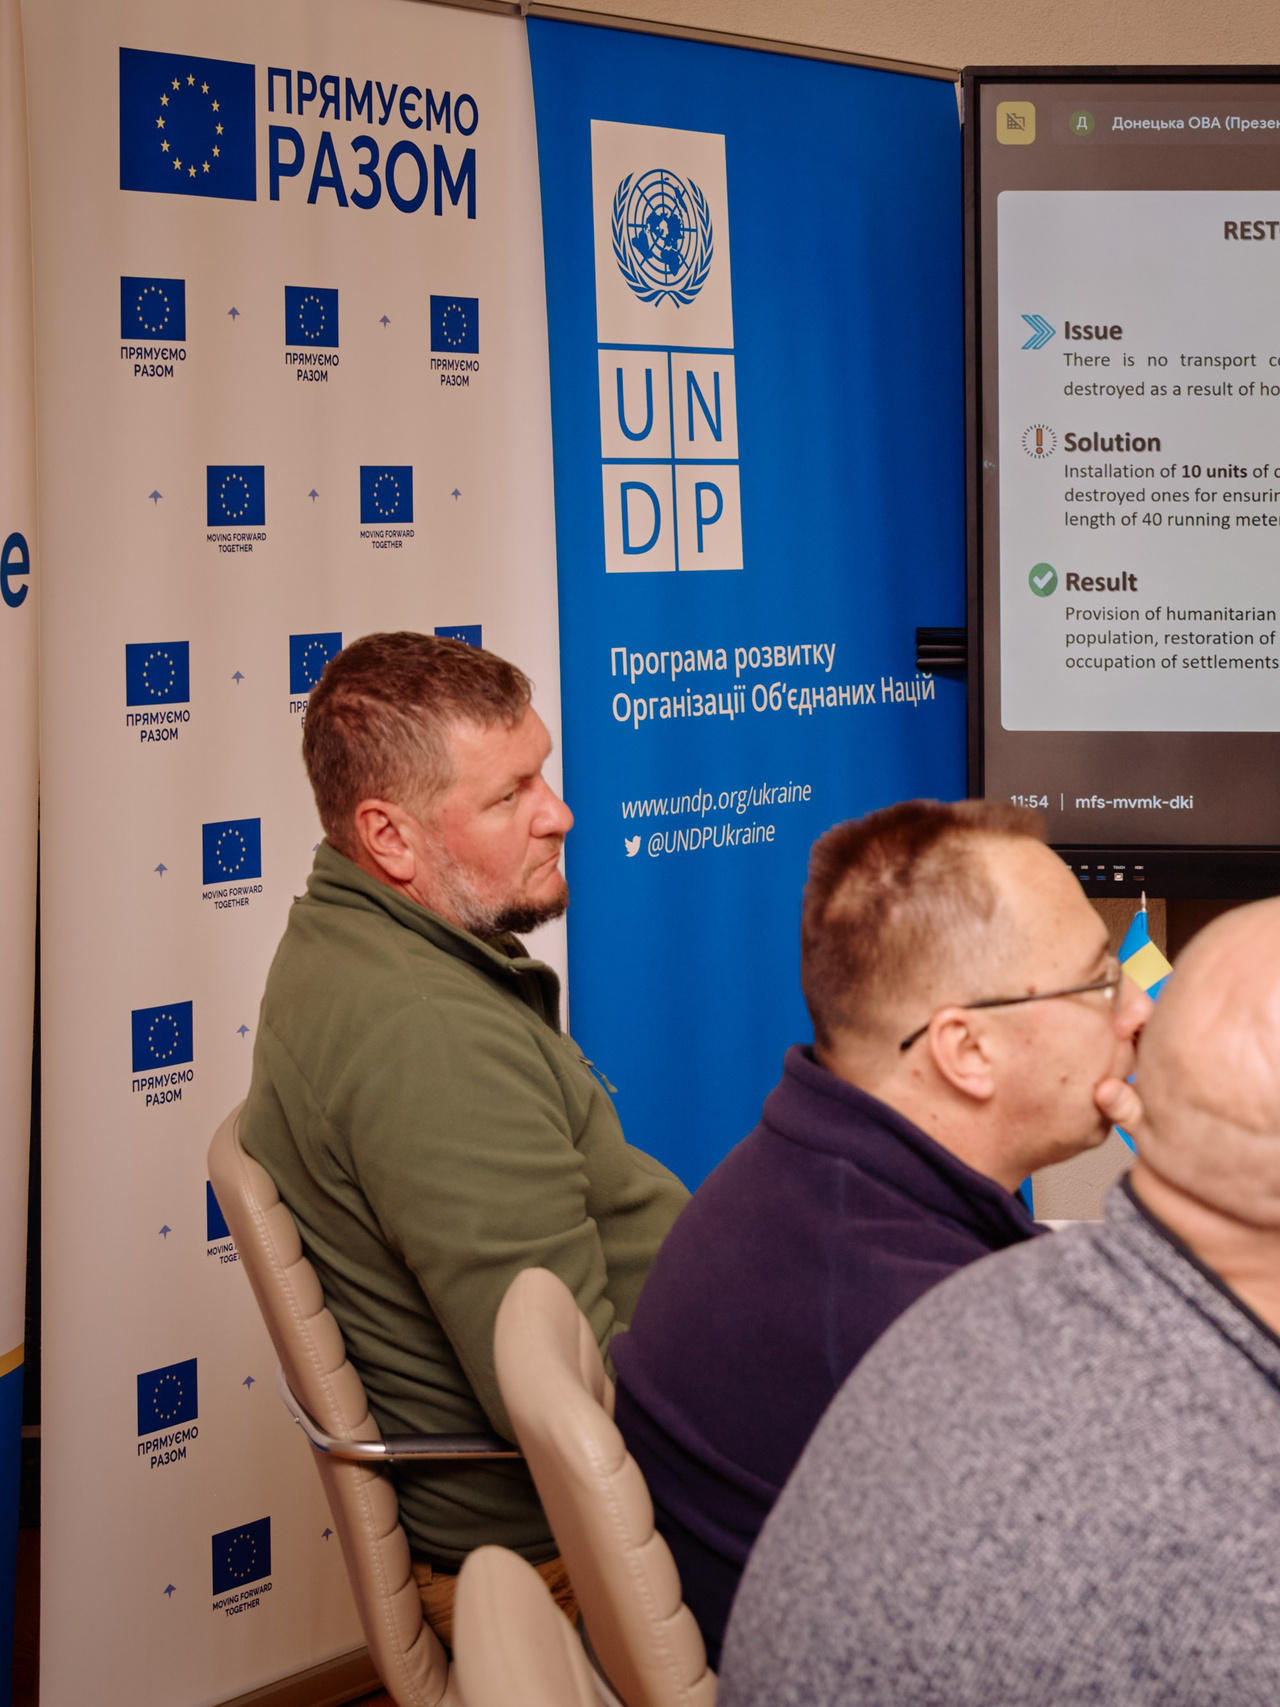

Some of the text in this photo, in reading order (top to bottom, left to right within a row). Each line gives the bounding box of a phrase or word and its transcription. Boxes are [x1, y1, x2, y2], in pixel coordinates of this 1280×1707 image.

[266, 66, 480, 137] ПРЯМУЄМО
[1111, 116, 1185, 132] Донецька
[1188, 116, 1222, 130] ОВА
[267, 124, 478, 220] РАЗОМ
[1064, 320, 1123, 341] Issue
[120, 346, 187, 362] ПРЯМУЄМО
[285, 352, 340, 367] ПРЯМУЄМО
[1062, 351, 1111, 367] There
[1123, 352, 1135, 367] is
[1147, 355, 1169, 367] no
[1179, 353, 1257, 371] transport
[134, 363, 174, 378] РАЗОМ
[430, 358, 480, 373] ПРЯМУЄМО
[296, 368, 329, 383] РАЗОМ
[439, 374, 470, 387] РАЗОМ
[1063, 381, 1145, 400] destroyed
[1150, 384, 1168, 397] as
[1172, 384, 1182, 397] a
[1187, 381, 1234, 397] result
[1238, 381, 1256, 397] of
[1064, 431, 1162, 453] Solution
[1064, 463, 1155, 479] Installation
[1159, 463, 1177, 479] of
[1181, 464, 1202, 479] 10
[1206, 463, 1248, 479] units
[1252, 463, 1270, 479] of
[1064, 487, 1146, 506] destroyed
[1150, 491, 1190, 503] ones
[1194, 487, 1218, 503] for
[1065, 511, 1116, 530] length
[1120, 511, 1138, 527] of
[1141, 512, 1163, 527] 40
[1167, 512, 1231, 530] running
[206, 531, 267, 543] MOVING FORWARD
[359, 529, 415, 539] MOVING FORWARD
[218, 543, 253, 553] TOGETHER
[371, 540, 403, 549] TOGETHER
[1065, 570, 1138, 593] Result
[1065, 606, 1140, 621] Provision
[1144, 605, 1162, 621] of
[1166, 606, 1276, 622] humanitarian
[1065, 629, 1159, 648] population,
[1164, 630, 1254, 645] restoration
[1259, 630, 1277, 646] of
[610, 642, 837, 685] Програма розвитку
[1065, 653, 1280, 672] occupation of settlements
[611, 684, 747, 730] Організації
[880, 672, 935, 708] Націй
[126, 709, 191, 727] ПРЯМУЄМО
[140, 727, 179, 743] РАЗОМ
[621, 780, 813, 819] www.undp.org/ukraine
[1009, 794, 1049, 809] 11:54
[1074, 794, 1194, 810] mfs-mvmk-dki
[647, 821, 776, 858] @UNDPUkraine
[201, 883, 264, 901] MOVING FORWARD
[214, 896, 250, 910] TOGETHER
[132, 1068, 194, 1093] ПРЯМУЄМО
[145, 1087, 182, 1108] РАЗОМ
[206, 1242, 234, 1257] MOVING
[137, 1426, 199, 1457] ПРЯМУЄМО
[150, 1446, 187, 1470] РАЗОМ
[212, 1581, 273, 1612] MOVING FORWARD
[224, 1597, 261, 1618] TOGETHER
